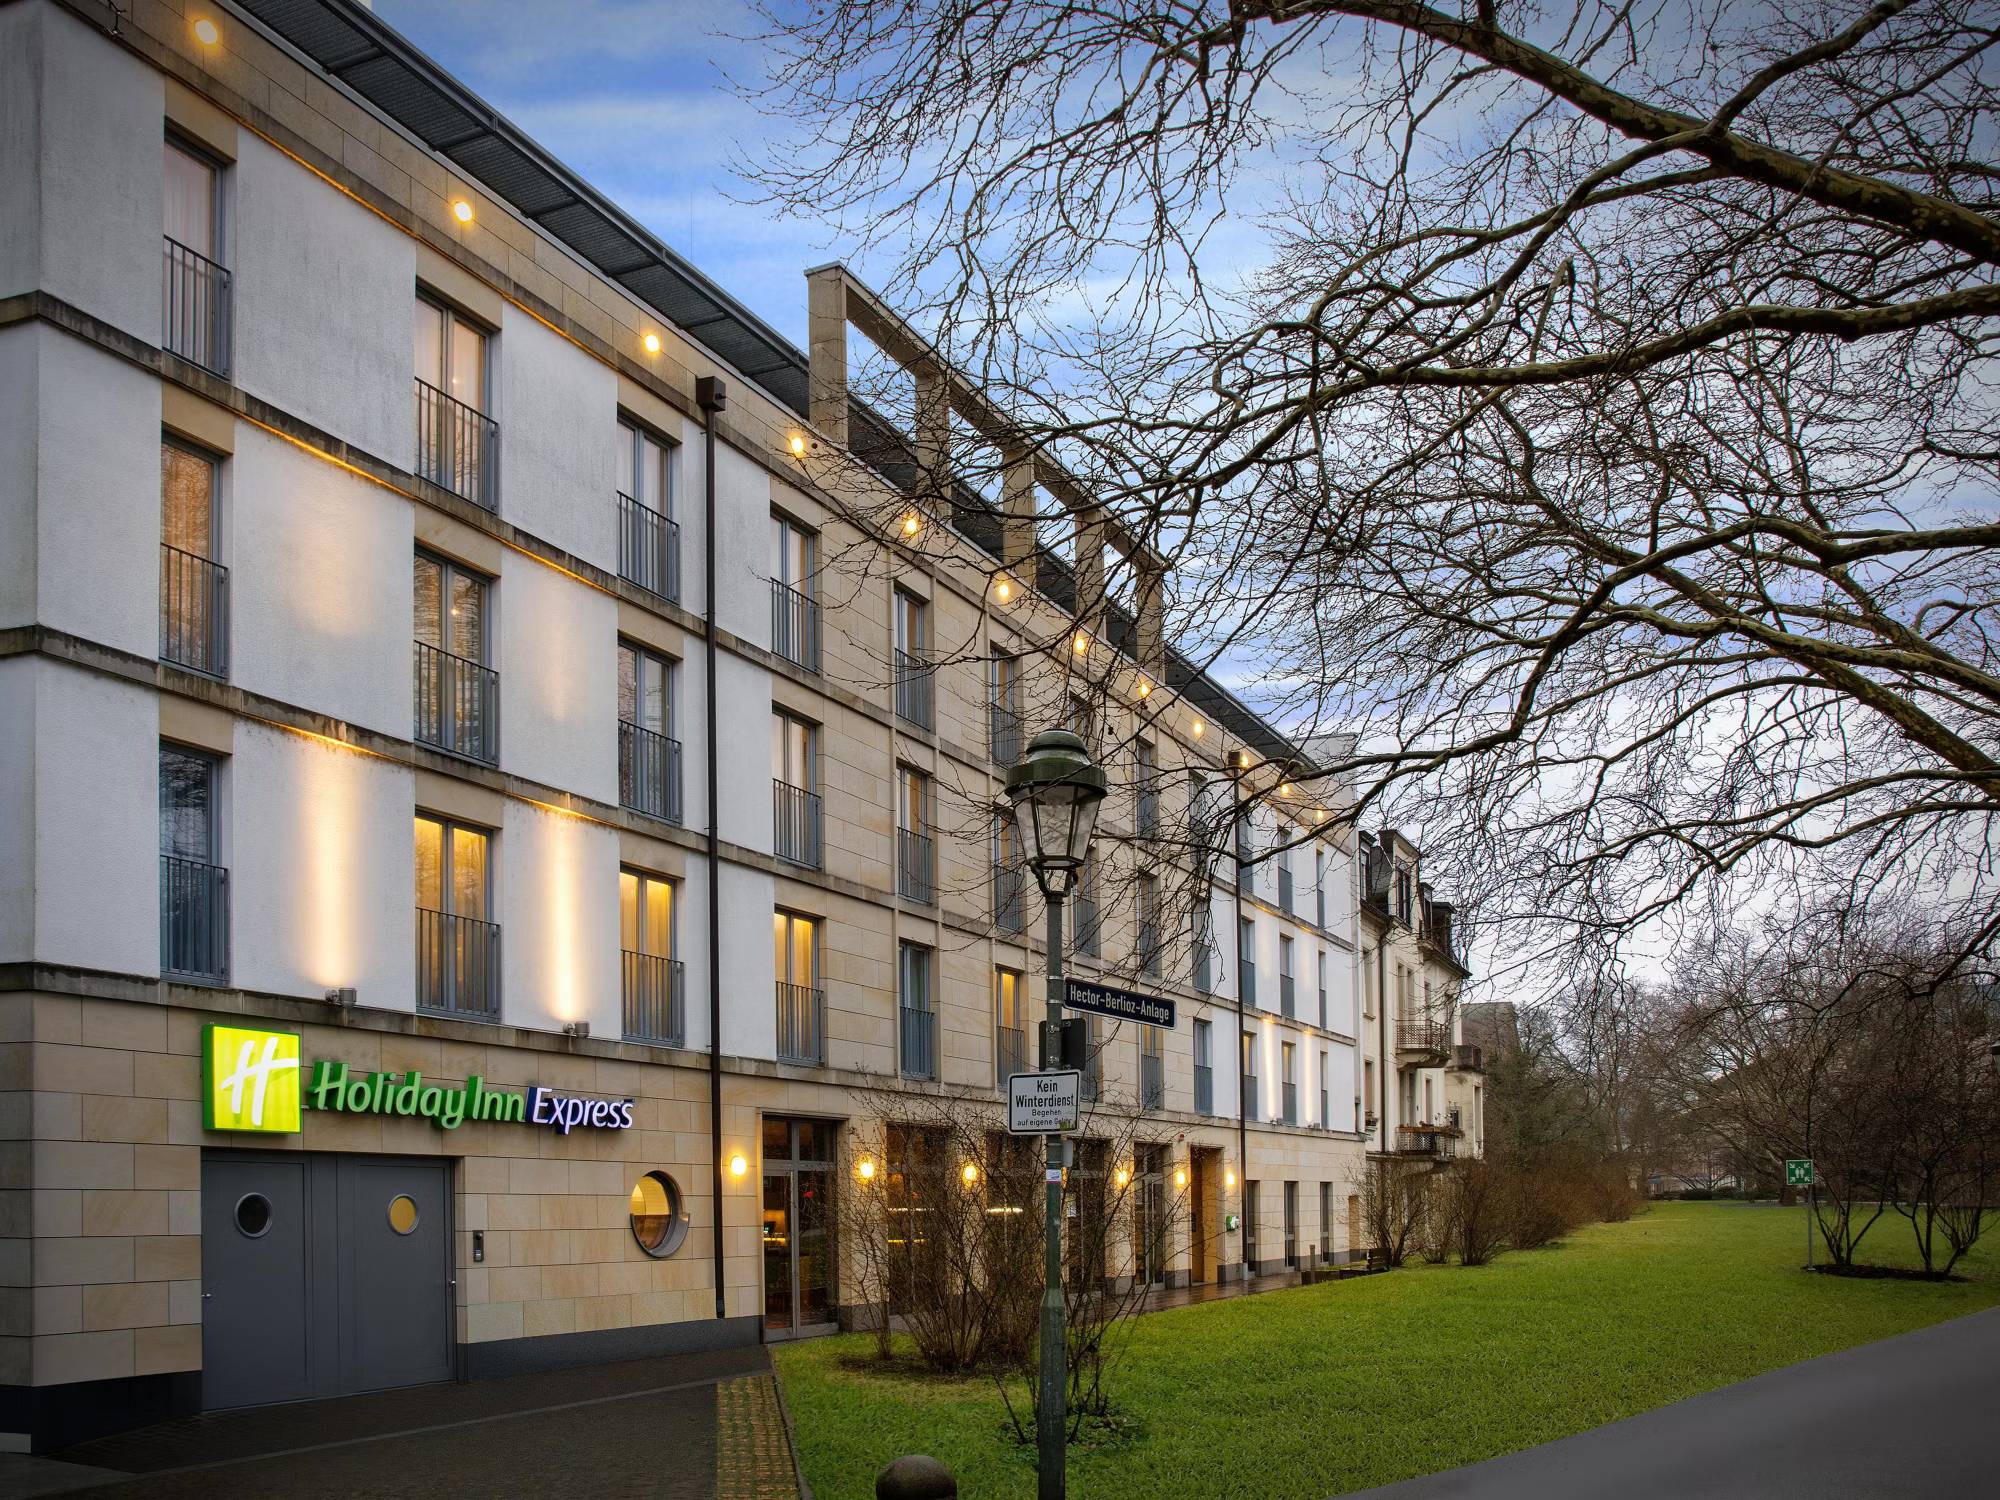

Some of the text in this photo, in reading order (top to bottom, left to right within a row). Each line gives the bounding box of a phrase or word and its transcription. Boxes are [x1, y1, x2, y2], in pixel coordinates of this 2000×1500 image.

[1070, 985, 1170, 1023] Hector-Berlioz-Anlage
[1037, 1079, 1058, 1093] Kein
[308, 1061, 634, 1135] Holiday Inn Express
[1015, 1093, 1074, 1108] Winterdienst
[1031, 1109, 1062, 1118] Begehen
[1029, 1119, 1053, 1128] eigene
